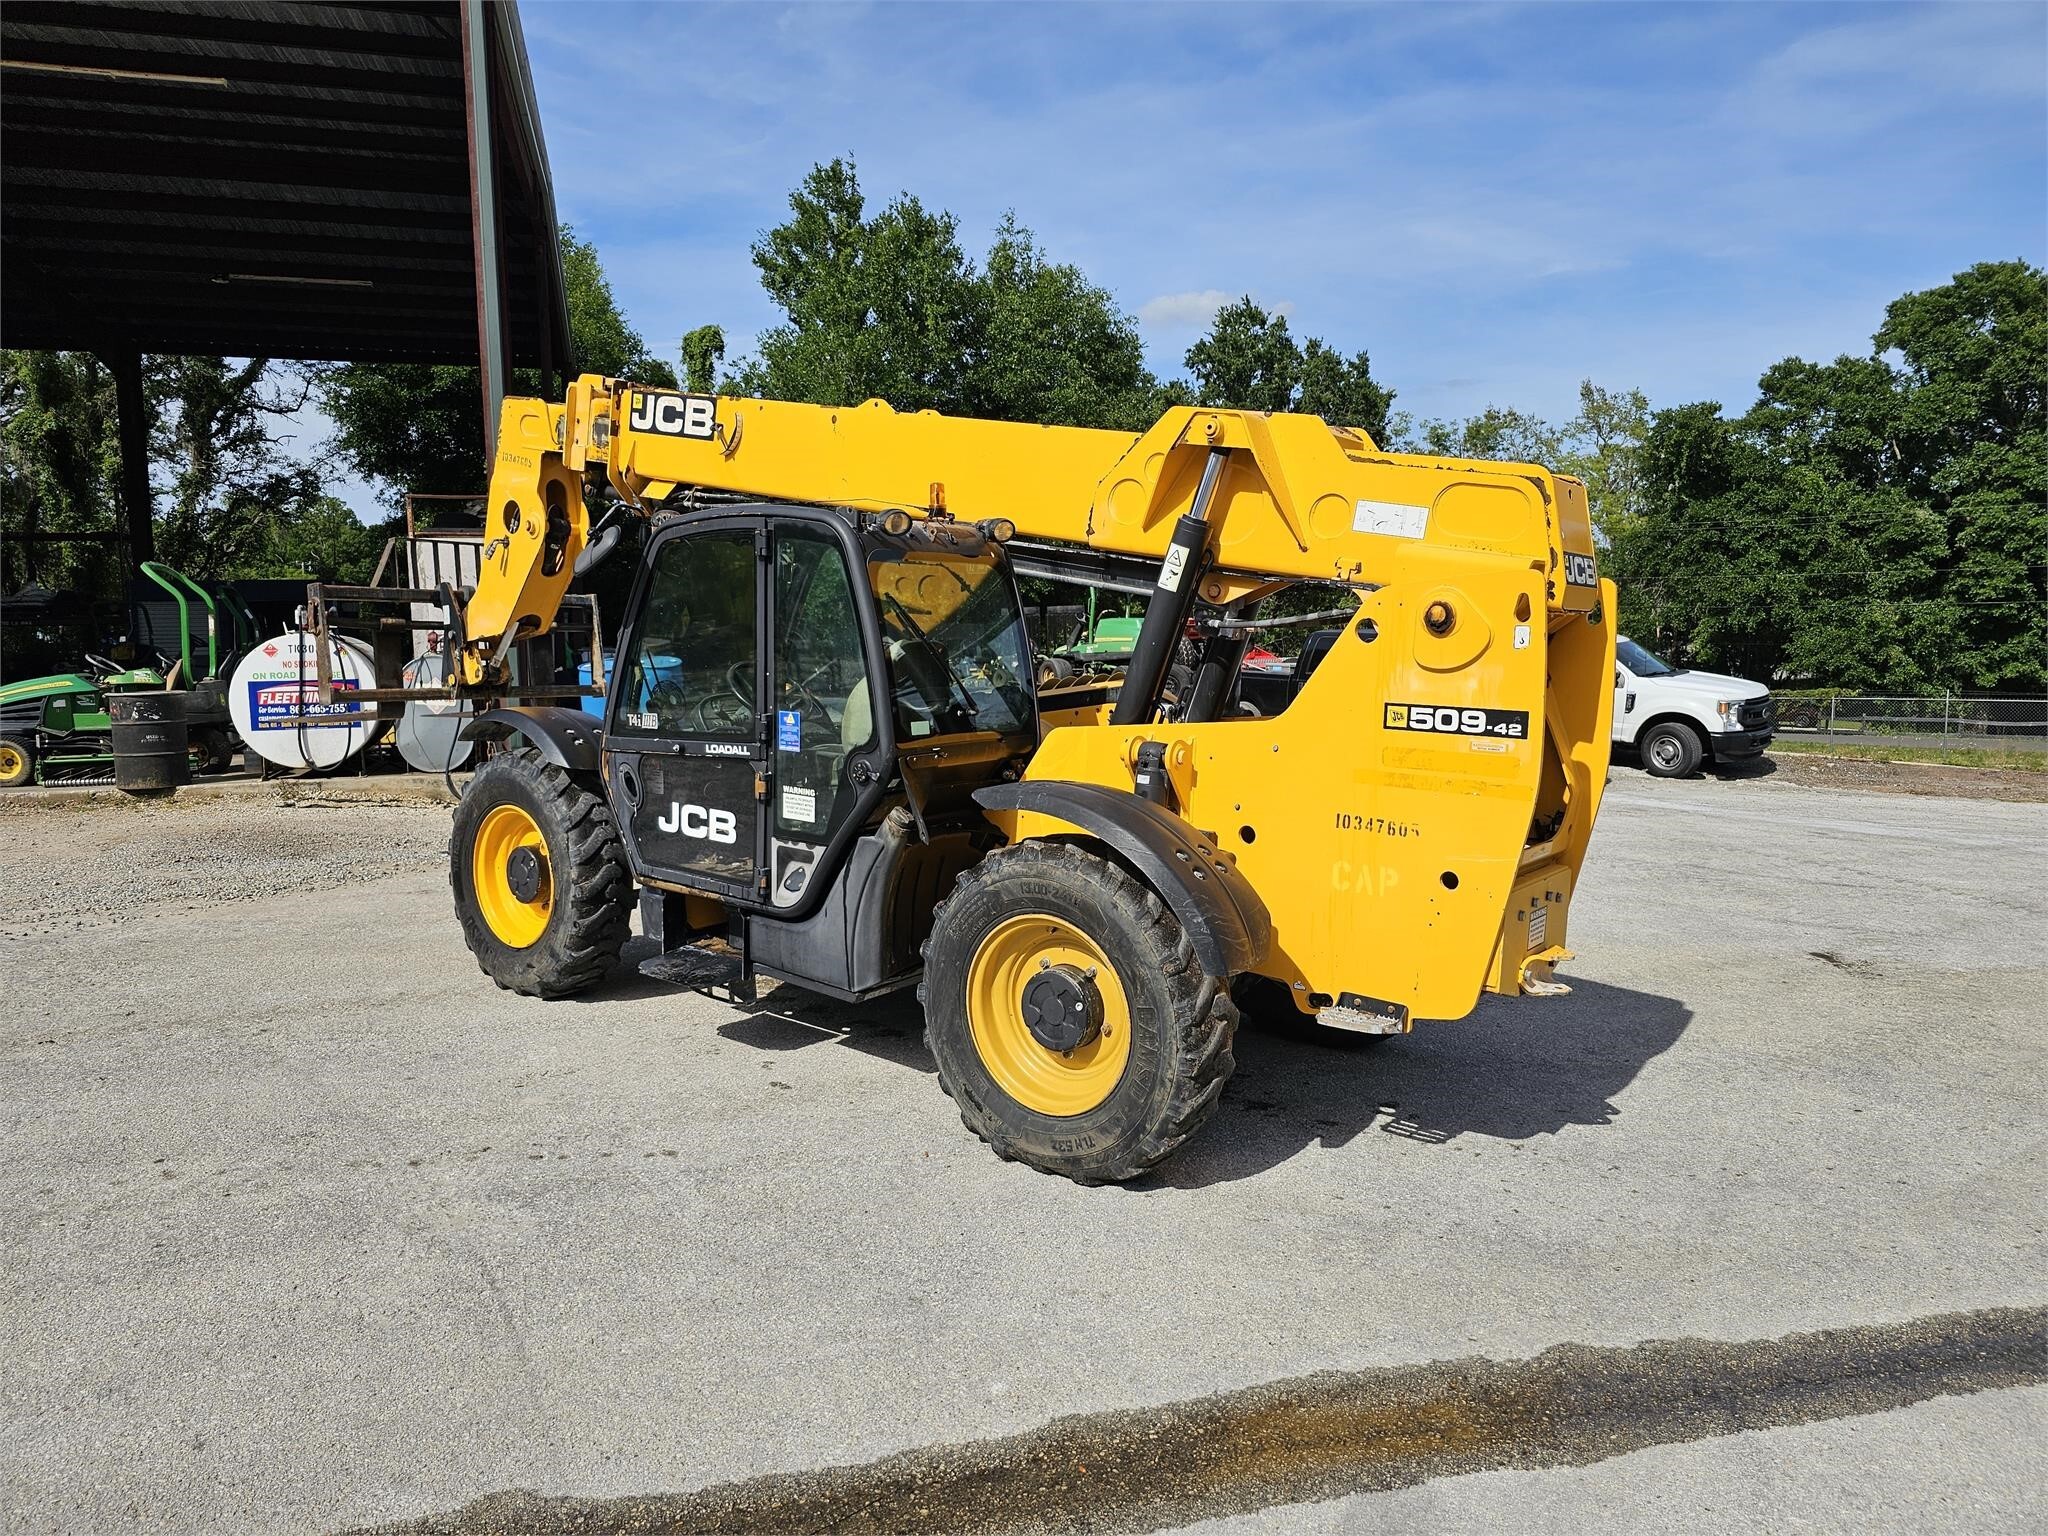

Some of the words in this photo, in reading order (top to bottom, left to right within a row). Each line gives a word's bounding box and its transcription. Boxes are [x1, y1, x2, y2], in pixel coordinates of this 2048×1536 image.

[630, 393, 714, 437] JCB
[1566, 555, 1596, 585] JCB
[252, 672, 267, 680] ON
[270, 671, 297, 679] ROAD
[282, 660, 292, 669] NO
[1409, 706, 1522, 736] 509-42
[705, 743, 750, 756] LOADALL
[782, 785, 816, 797] WARNING
[658, 801, 736, 844] JCB
[1332, 860, 1399, 897] CAP
